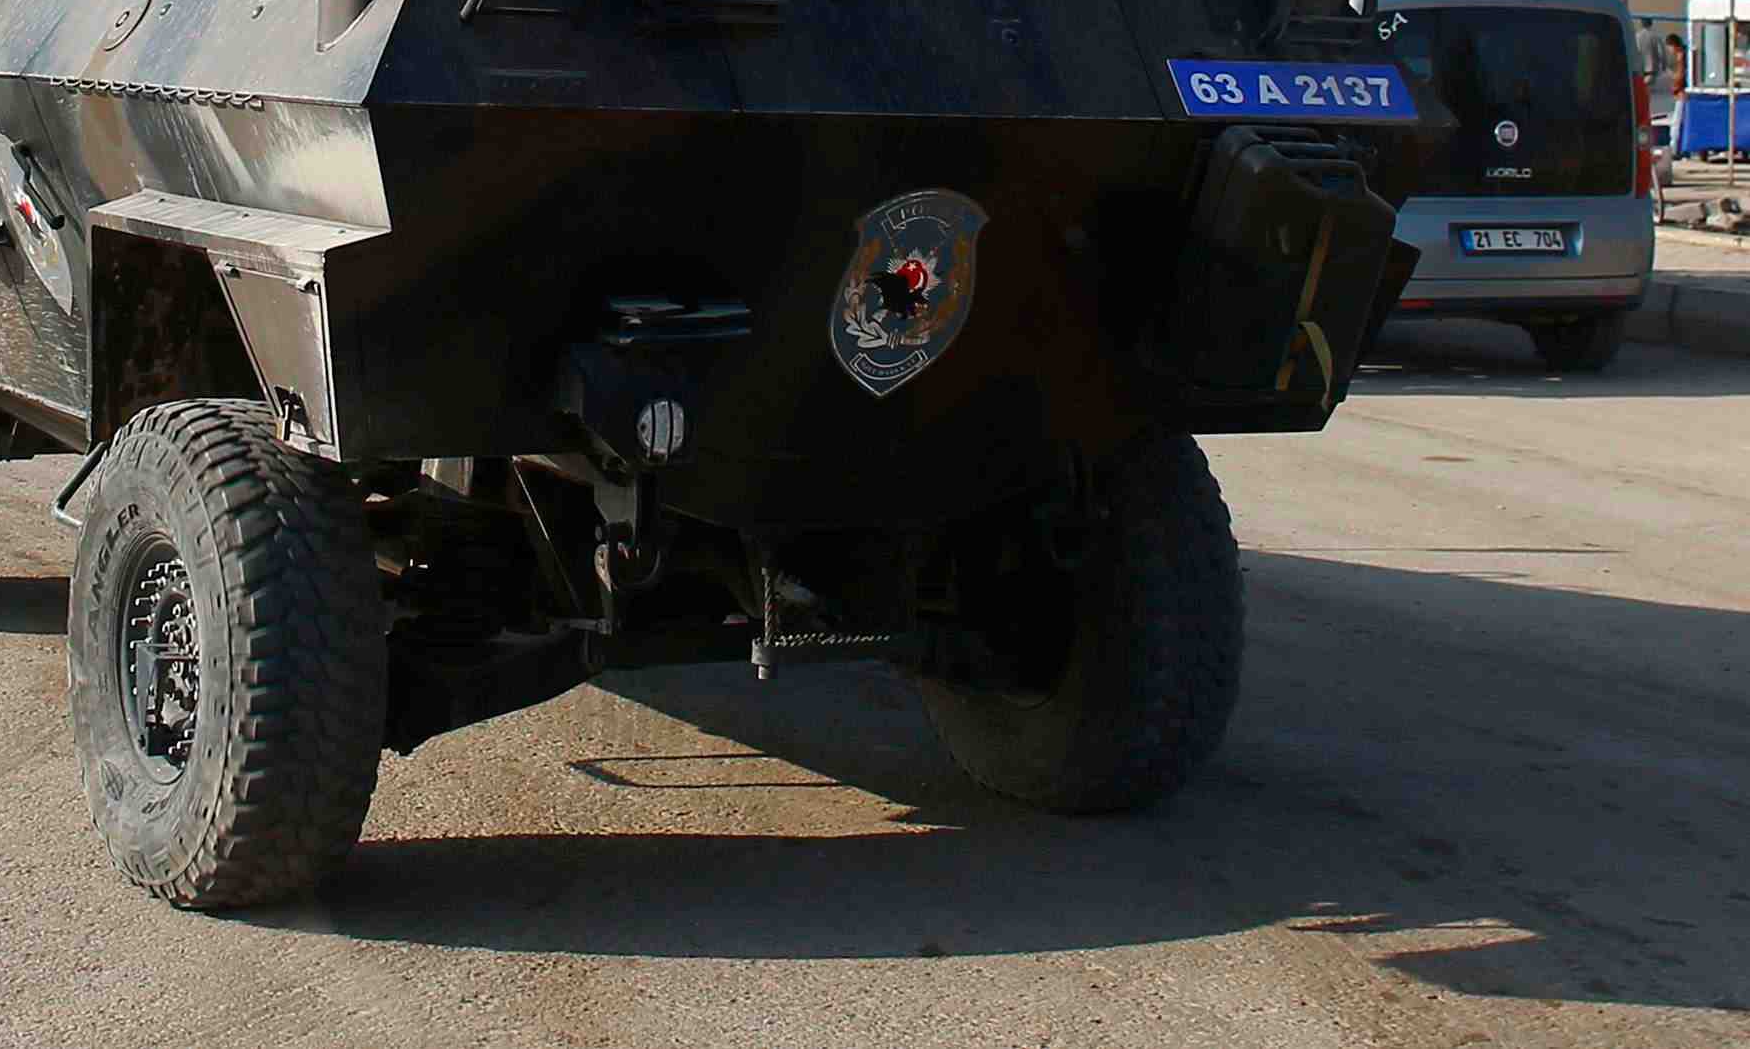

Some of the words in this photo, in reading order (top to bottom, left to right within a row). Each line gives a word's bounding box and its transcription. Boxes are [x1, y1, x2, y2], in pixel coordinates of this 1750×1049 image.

[1189, 72, 1246, 105] 63
[1258, 74, 1291, 105] A
[1294, 74, 1392, 107] 2137
[1473, 231, 1492, 248] 21
[1502, 231, 1523, 248] EC
[1533, 231, 1562, 248] 704
